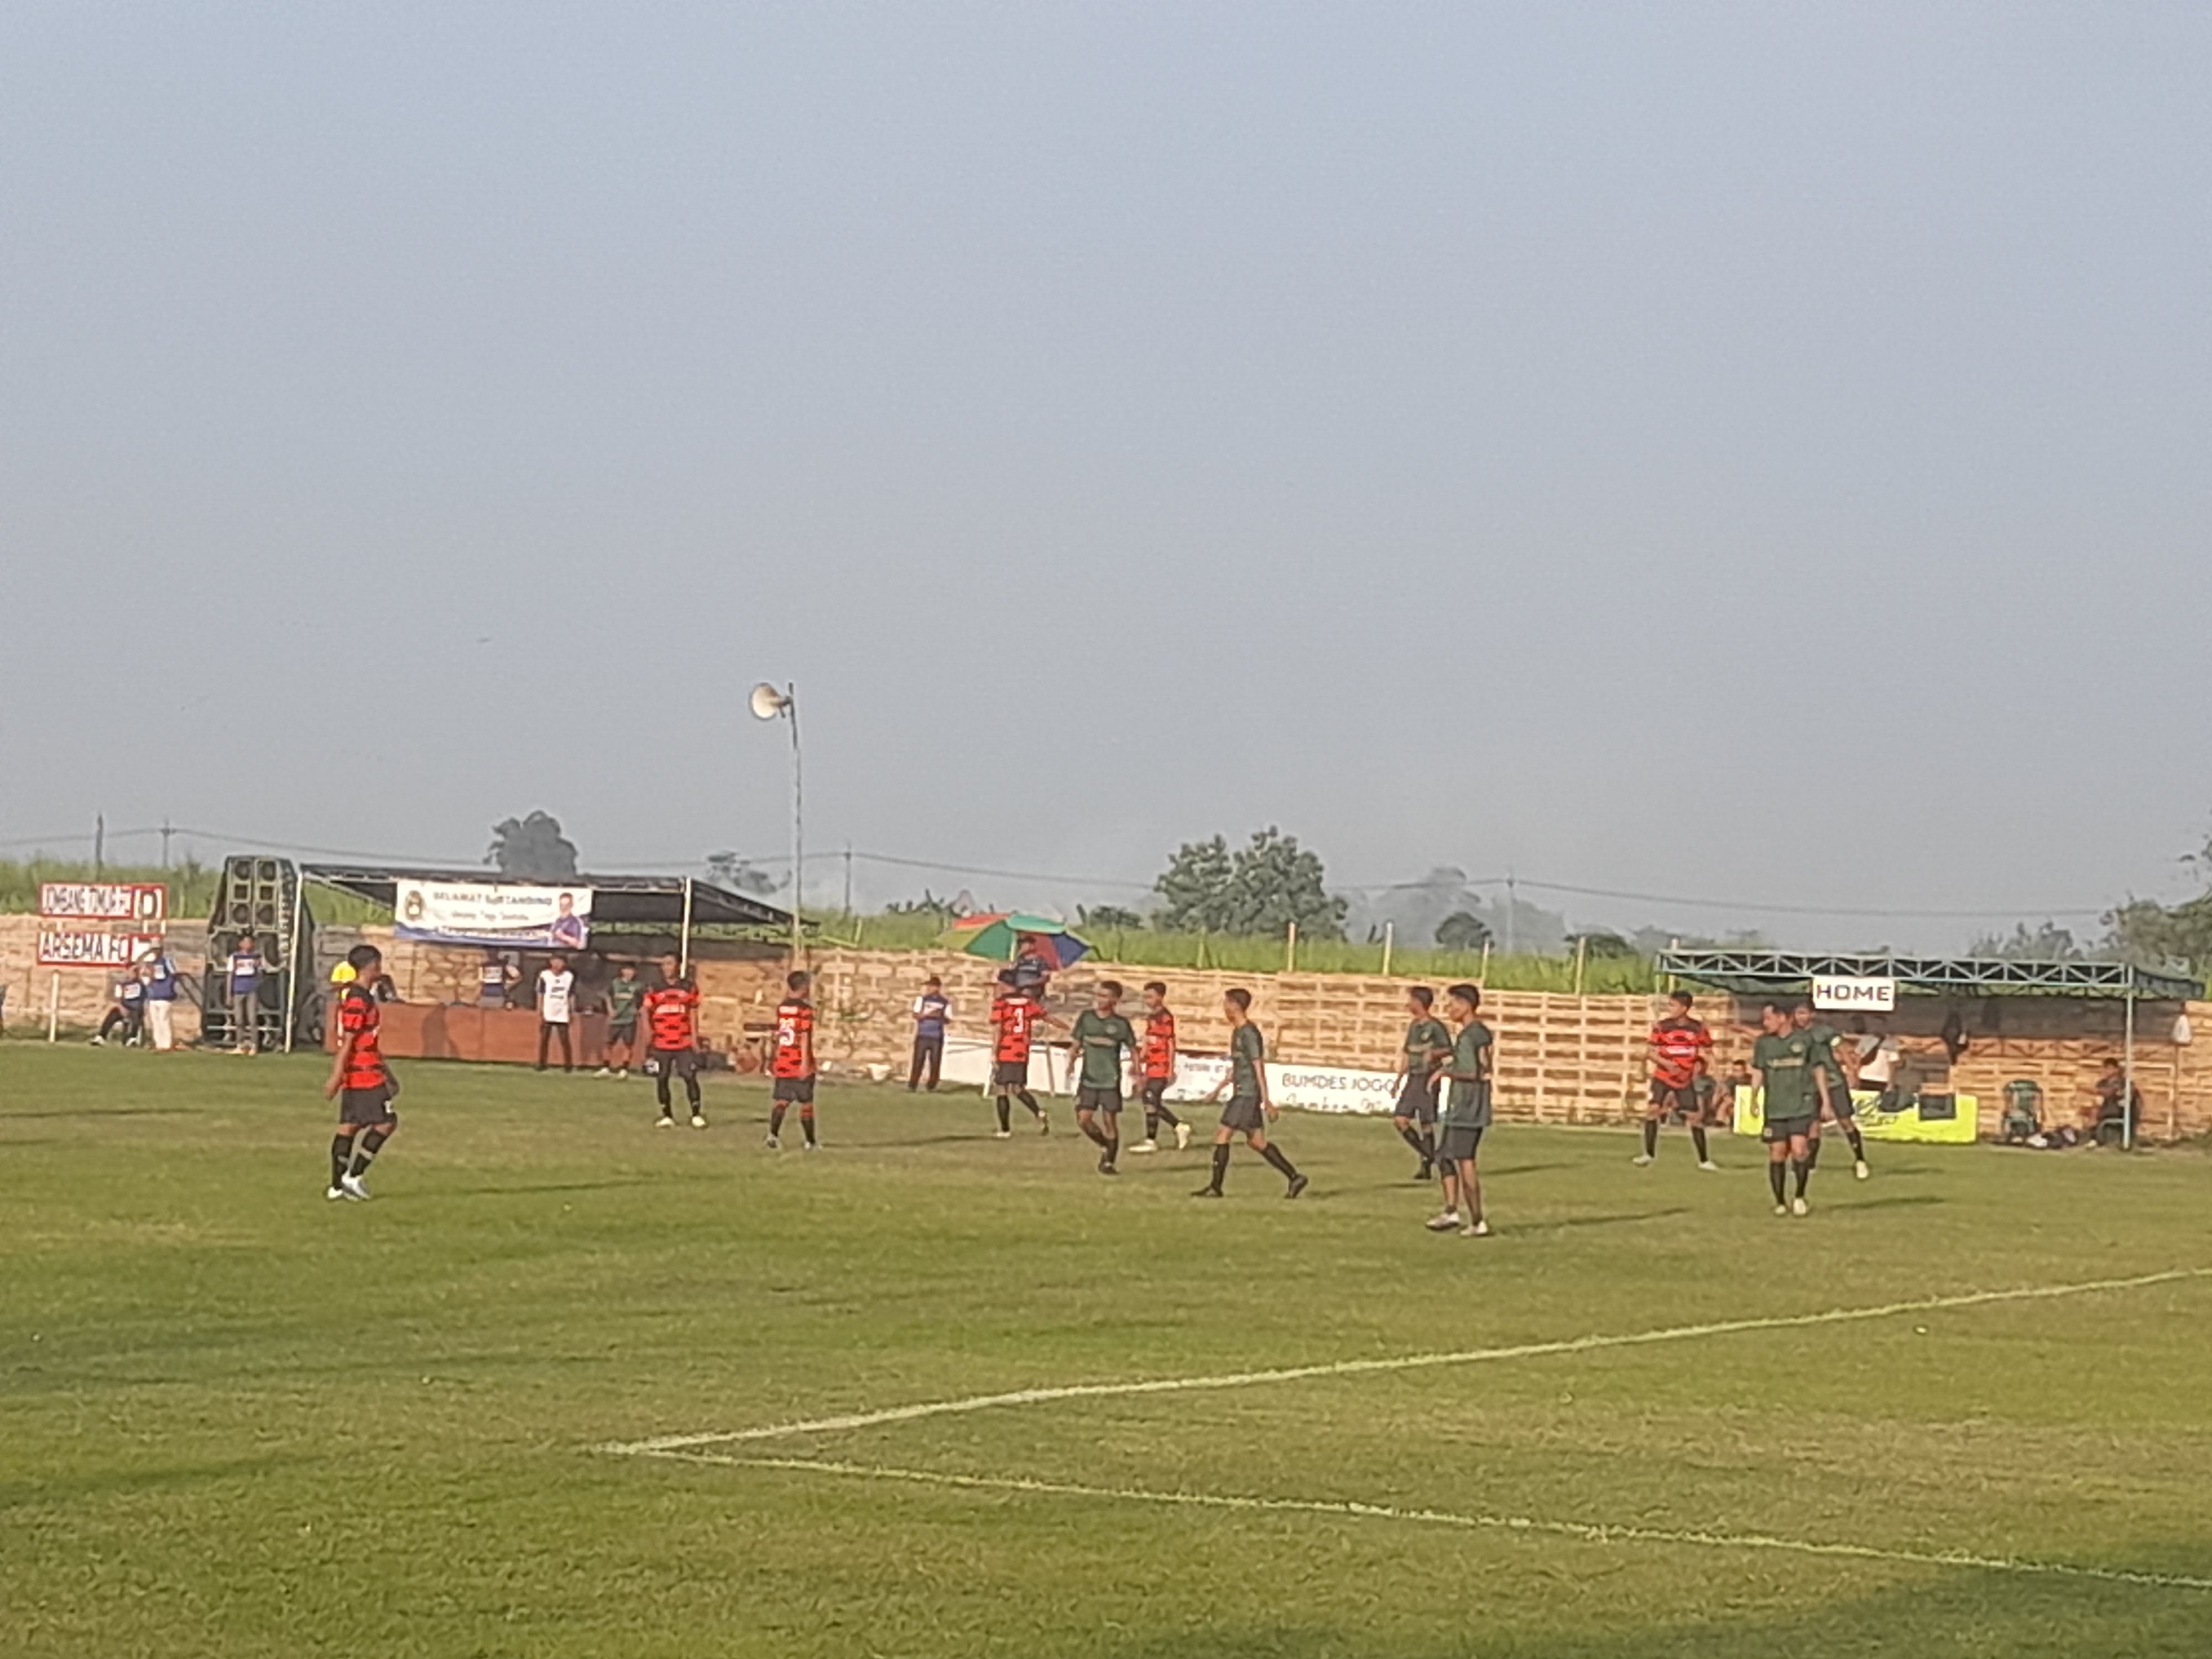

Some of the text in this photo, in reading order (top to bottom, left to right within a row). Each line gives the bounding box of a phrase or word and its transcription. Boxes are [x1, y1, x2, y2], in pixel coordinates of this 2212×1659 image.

[42, 933, 105, 961] ARSEMA
[108, 934, 128, 962] FC
[1816, 984, 1891, 1001] HOME
[1282, 1073, 1346, 1090] BUMDES
